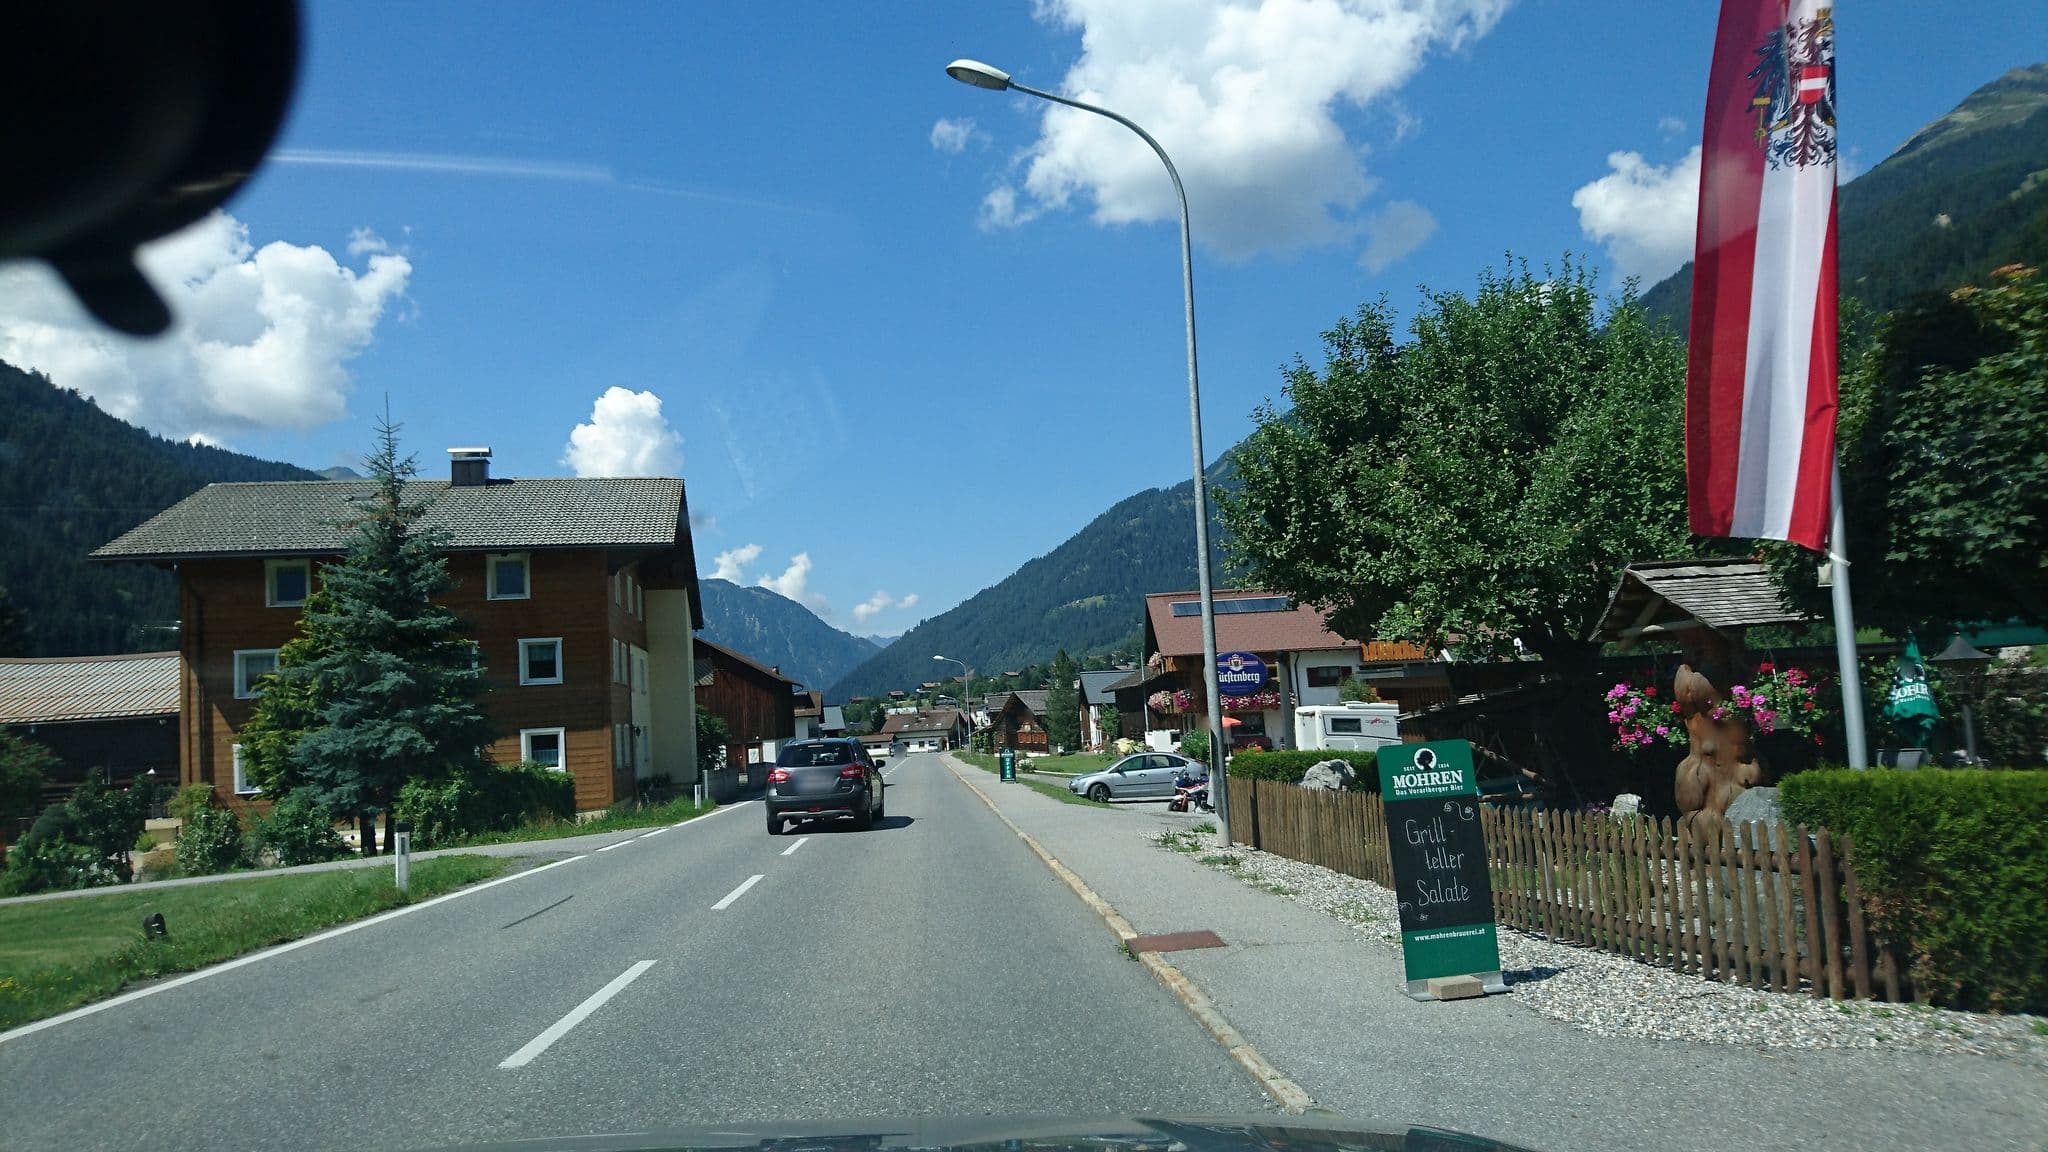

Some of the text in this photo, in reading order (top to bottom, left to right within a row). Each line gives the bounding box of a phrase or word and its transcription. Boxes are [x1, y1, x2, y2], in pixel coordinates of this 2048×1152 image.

[1217, 670, 1260, 684] ürstenberg
[1392, 769, 1463, 789] MOHREN
[1408, 786, 1449, 795] Vorarlberger
[1425, 846, 1465, 870] teller
[1416, 876, 1470, 906] Salate
[1414, 928, 1486, 942] www.mohrenbrauerei.at
